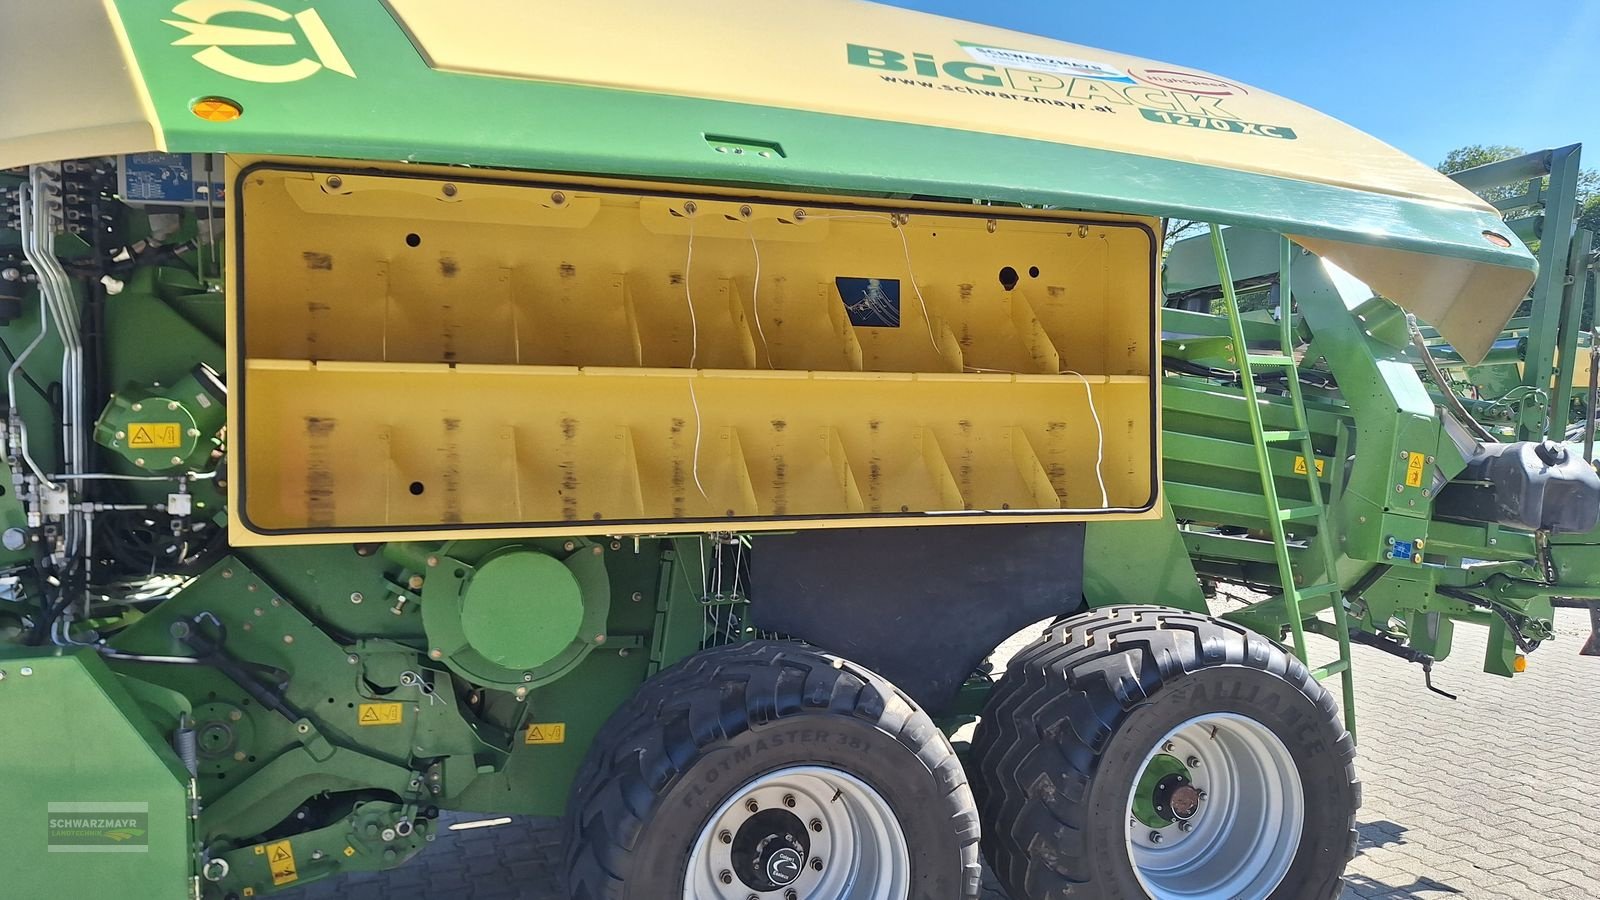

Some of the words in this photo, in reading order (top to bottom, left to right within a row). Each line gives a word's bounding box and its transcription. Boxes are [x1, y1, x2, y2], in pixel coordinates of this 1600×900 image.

[880, 75, 1117, 114] www.schwarzmayr.at
[1155, 111, 1231, 131] 1270
[1237, 121, 1284, 138] XC
[682, 729, 830, 809] FLOTMASTER
[836, 732, 872, 754] 381
